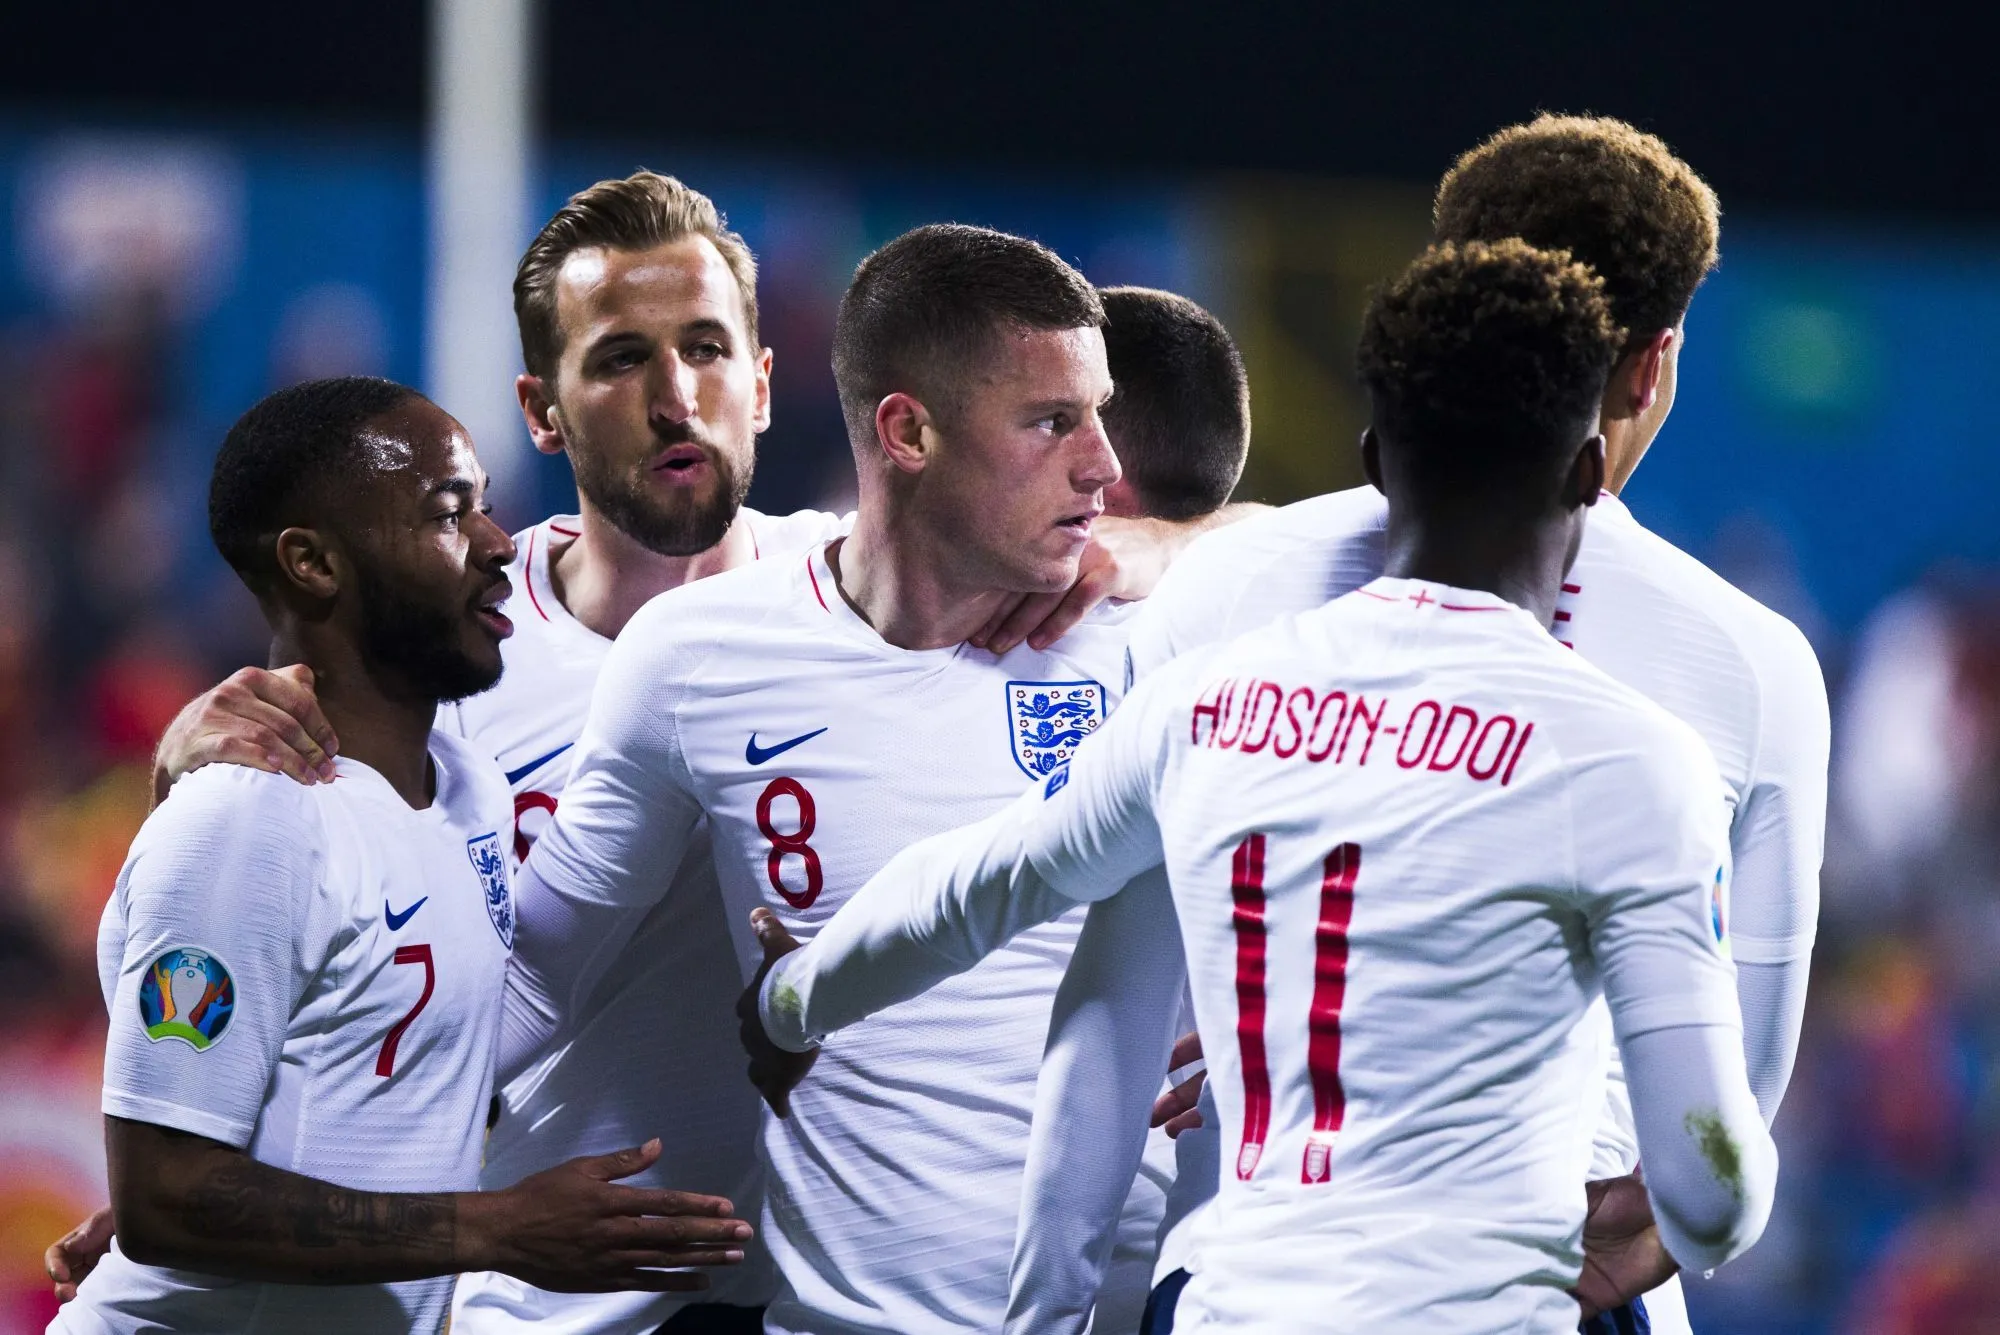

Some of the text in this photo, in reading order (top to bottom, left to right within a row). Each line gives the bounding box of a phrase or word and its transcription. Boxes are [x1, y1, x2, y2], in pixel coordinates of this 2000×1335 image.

[1192, 678, 1534, 786] HUDSON-ODOI
[756, 776, 823, 909] 8
[375, 944, 435, 1077] 7
[1231, 833, 1361, 1184] 11
